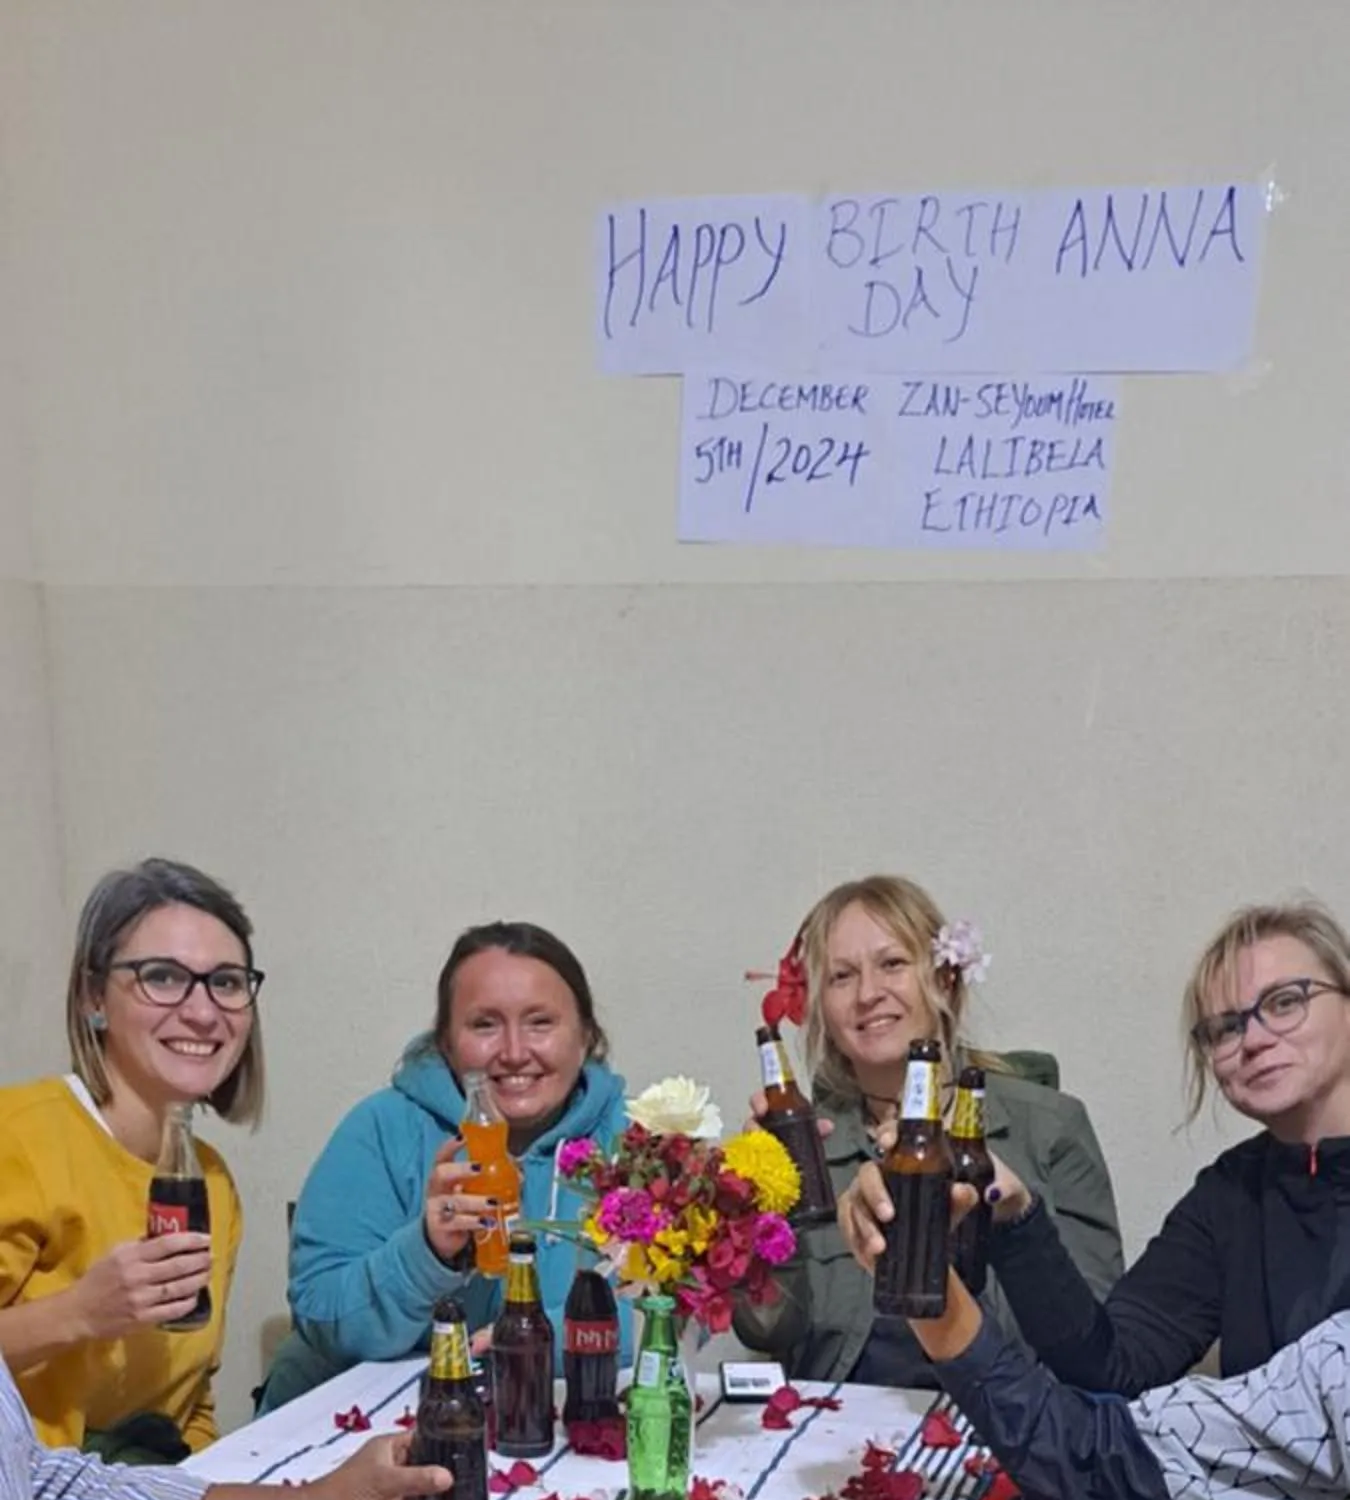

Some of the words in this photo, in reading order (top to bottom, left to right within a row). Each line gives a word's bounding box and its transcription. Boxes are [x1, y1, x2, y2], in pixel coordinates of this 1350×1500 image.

[604, 208, 787, 340] HAPPY
[826, 196, 1022, 268] BIRTH
[1055, 186, 1245, 278] ANNA
[847, 256, 979, 343] DAY
[696, 377, 869, 420] DECEMBER
[934, 433, 1106, 479] LALIBELA
[921, 487, 1101, 536] ETHIOPIA
